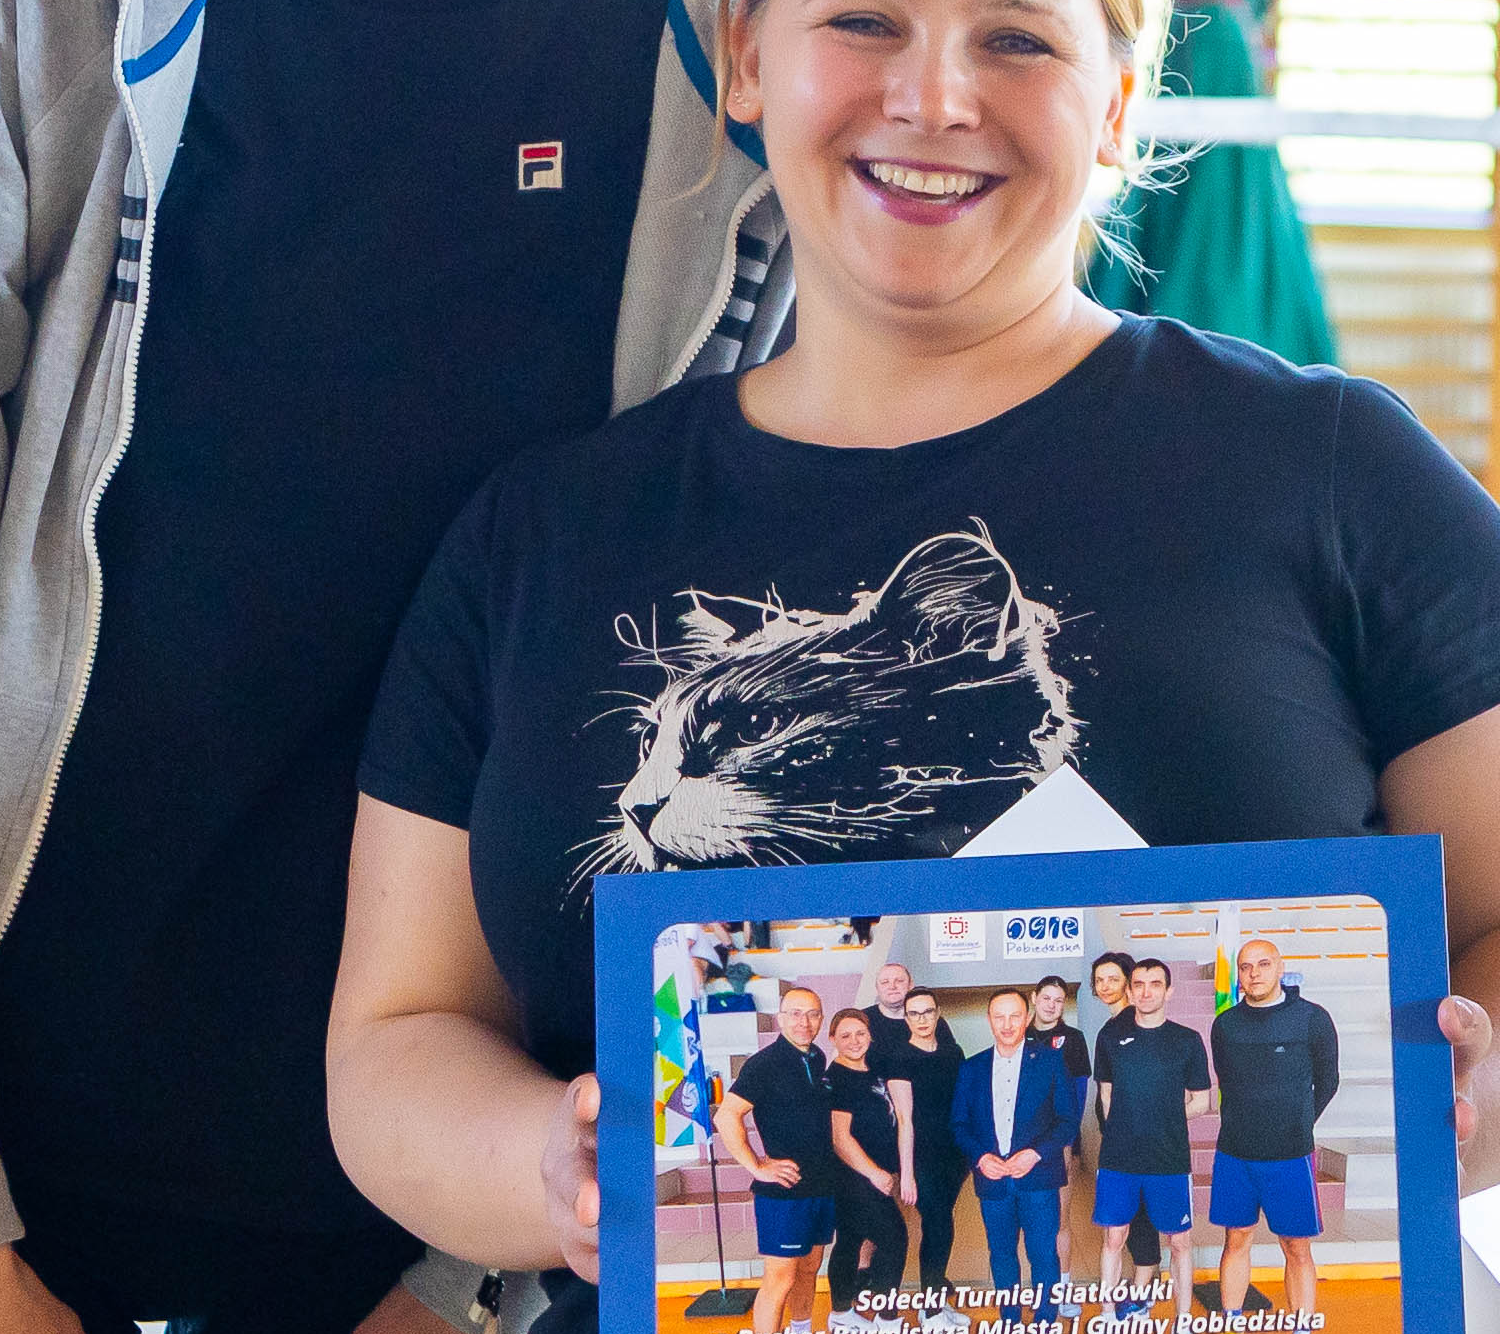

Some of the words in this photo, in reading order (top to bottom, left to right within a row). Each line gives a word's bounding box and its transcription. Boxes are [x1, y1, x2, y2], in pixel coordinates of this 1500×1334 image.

[856, 1286, 946, 1312] Sołecki
[954, 1281, 1043, 1308] Turniej
[1050, 1279, 1174, 1304] Siatkówki
[1176, 1309, 1325, 1334] Pobiedziska
